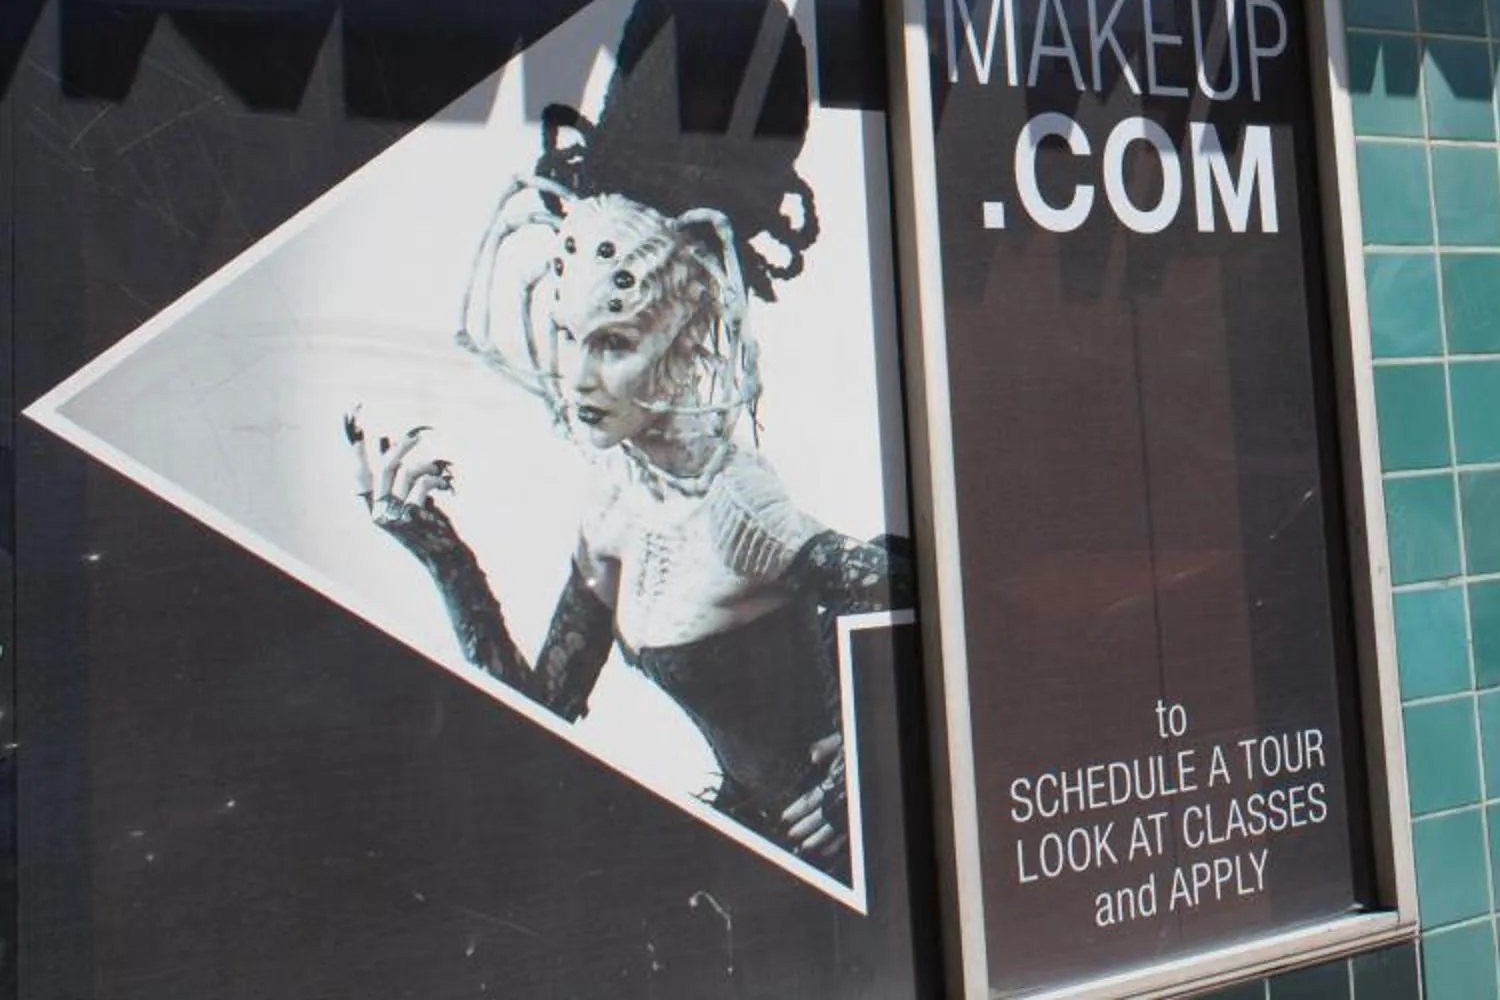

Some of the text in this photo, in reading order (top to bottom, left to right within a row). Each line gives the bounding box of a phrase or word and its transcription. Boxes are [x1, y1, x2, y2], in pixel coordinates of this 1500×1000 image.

[982, 111, 1280, 234] .COM
[1156, 699, 1187, 739] to
[1010, 728, 1326, 823] SCHEDULE A TOUR
[1016, 783, 1328, 884] LOOK AT CLASSES
[1094, 848, 1269, 927] and APPLY
